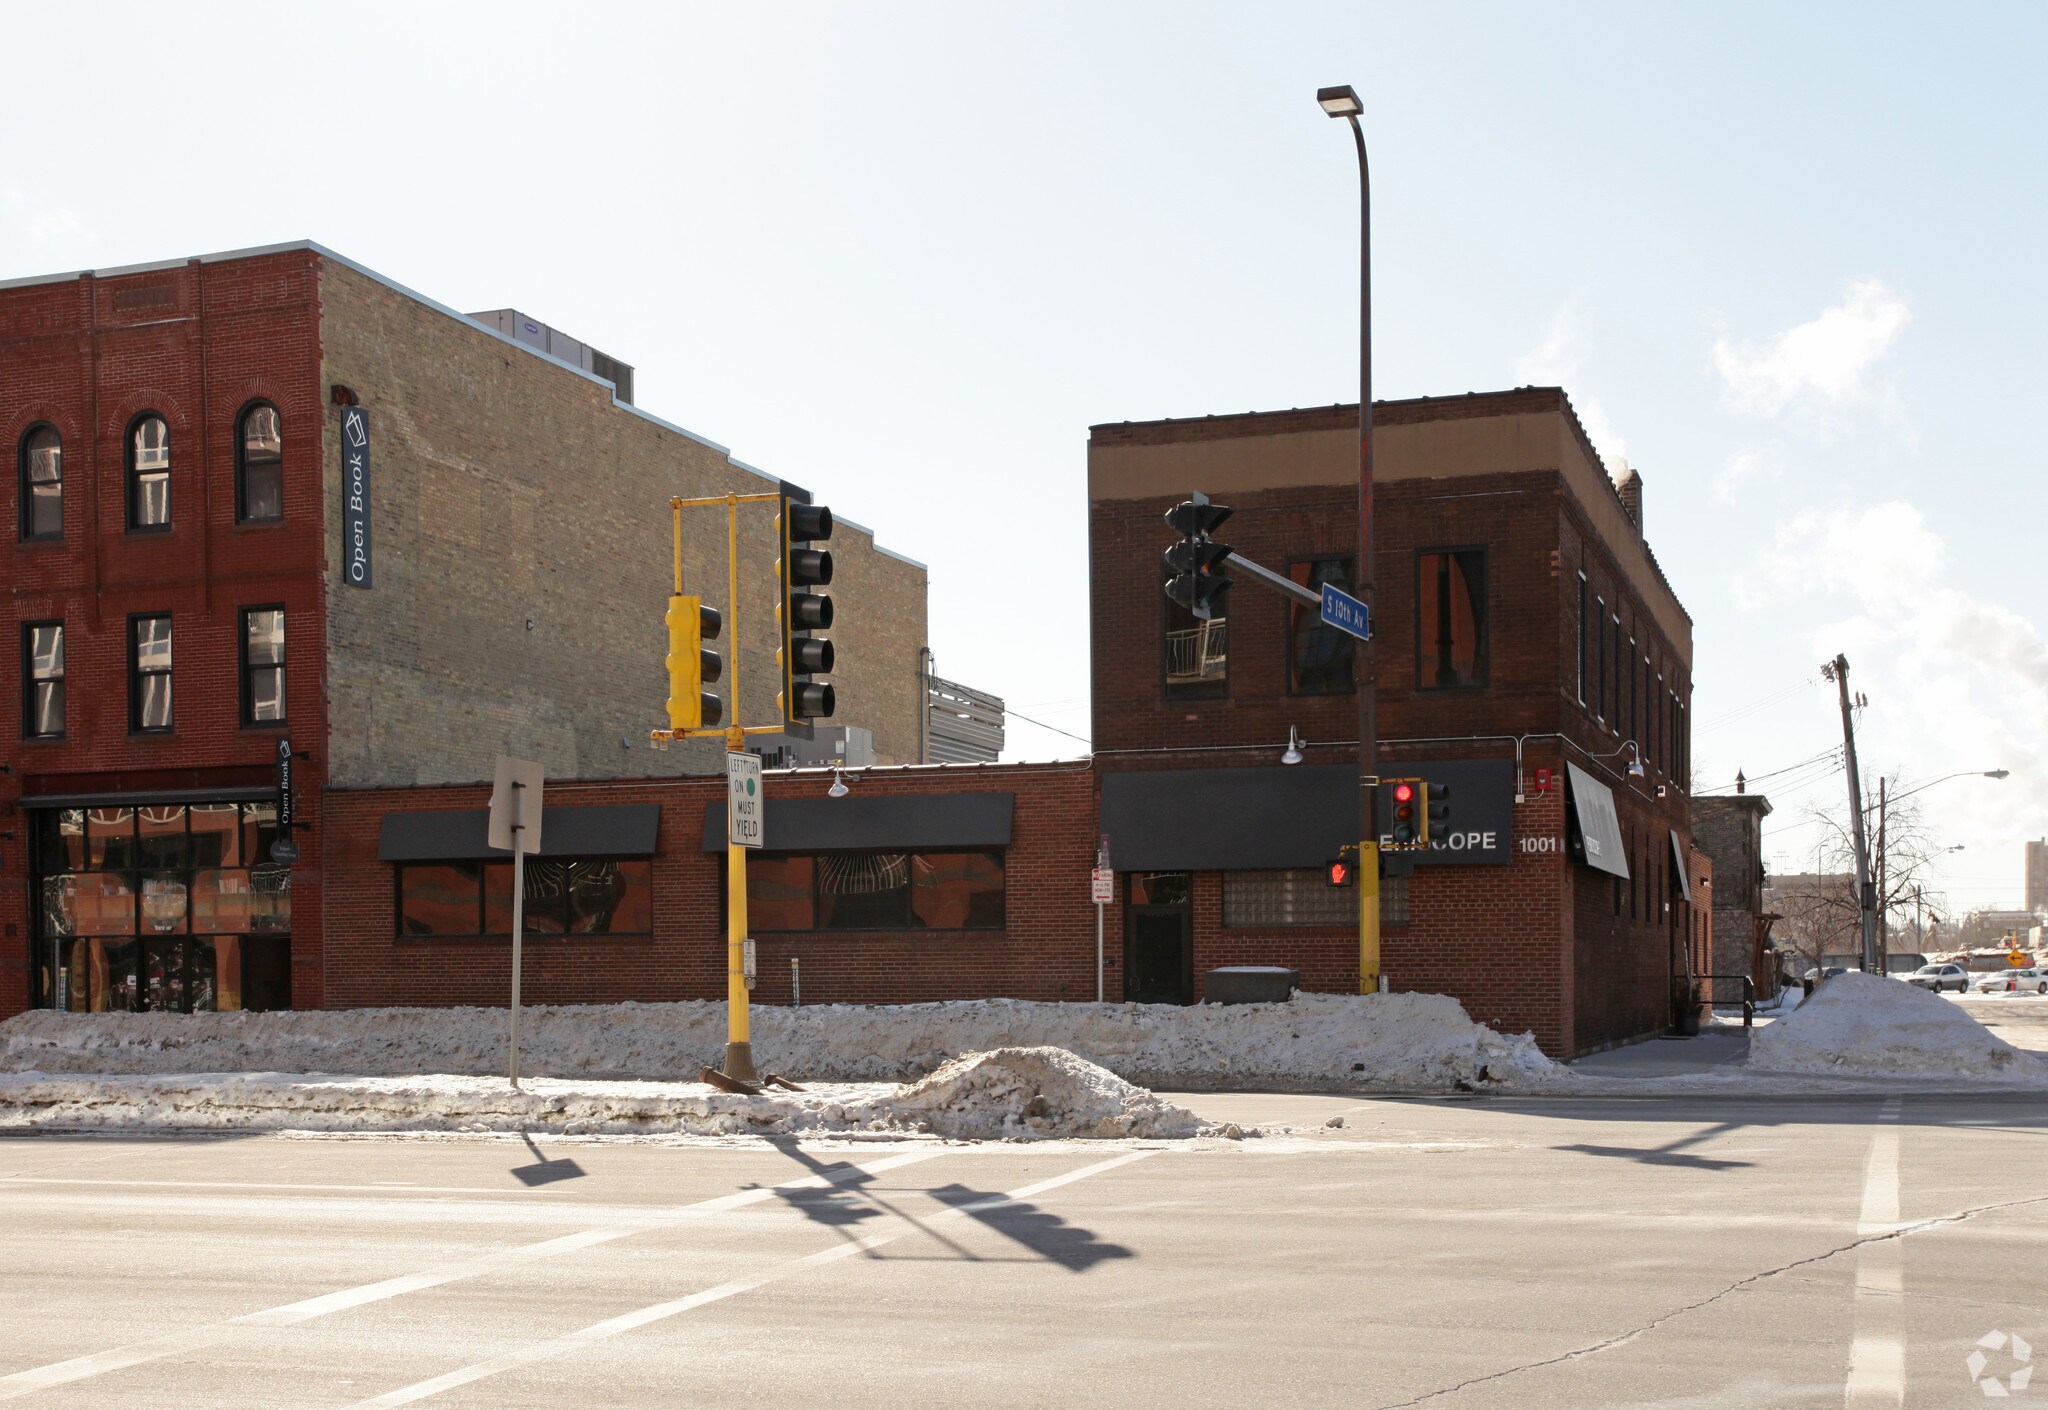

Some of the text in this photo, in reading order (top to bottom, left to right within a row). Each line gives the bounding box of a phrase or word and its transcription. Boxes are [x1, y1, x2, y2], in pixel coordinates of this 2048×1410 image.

[350, 452, 367, 582] Open Book
[1327, 594, 1333, 614] S
[730, 757, 760, 776] LEFT TURN
[281, 760, 290, 824] Open Book
[734, 779, 744, 794] ON
[737, 801, 755, 816] MUST
[736, 818, 758, 838] YIELD
[1519, 836, 1556, 853] 1001
